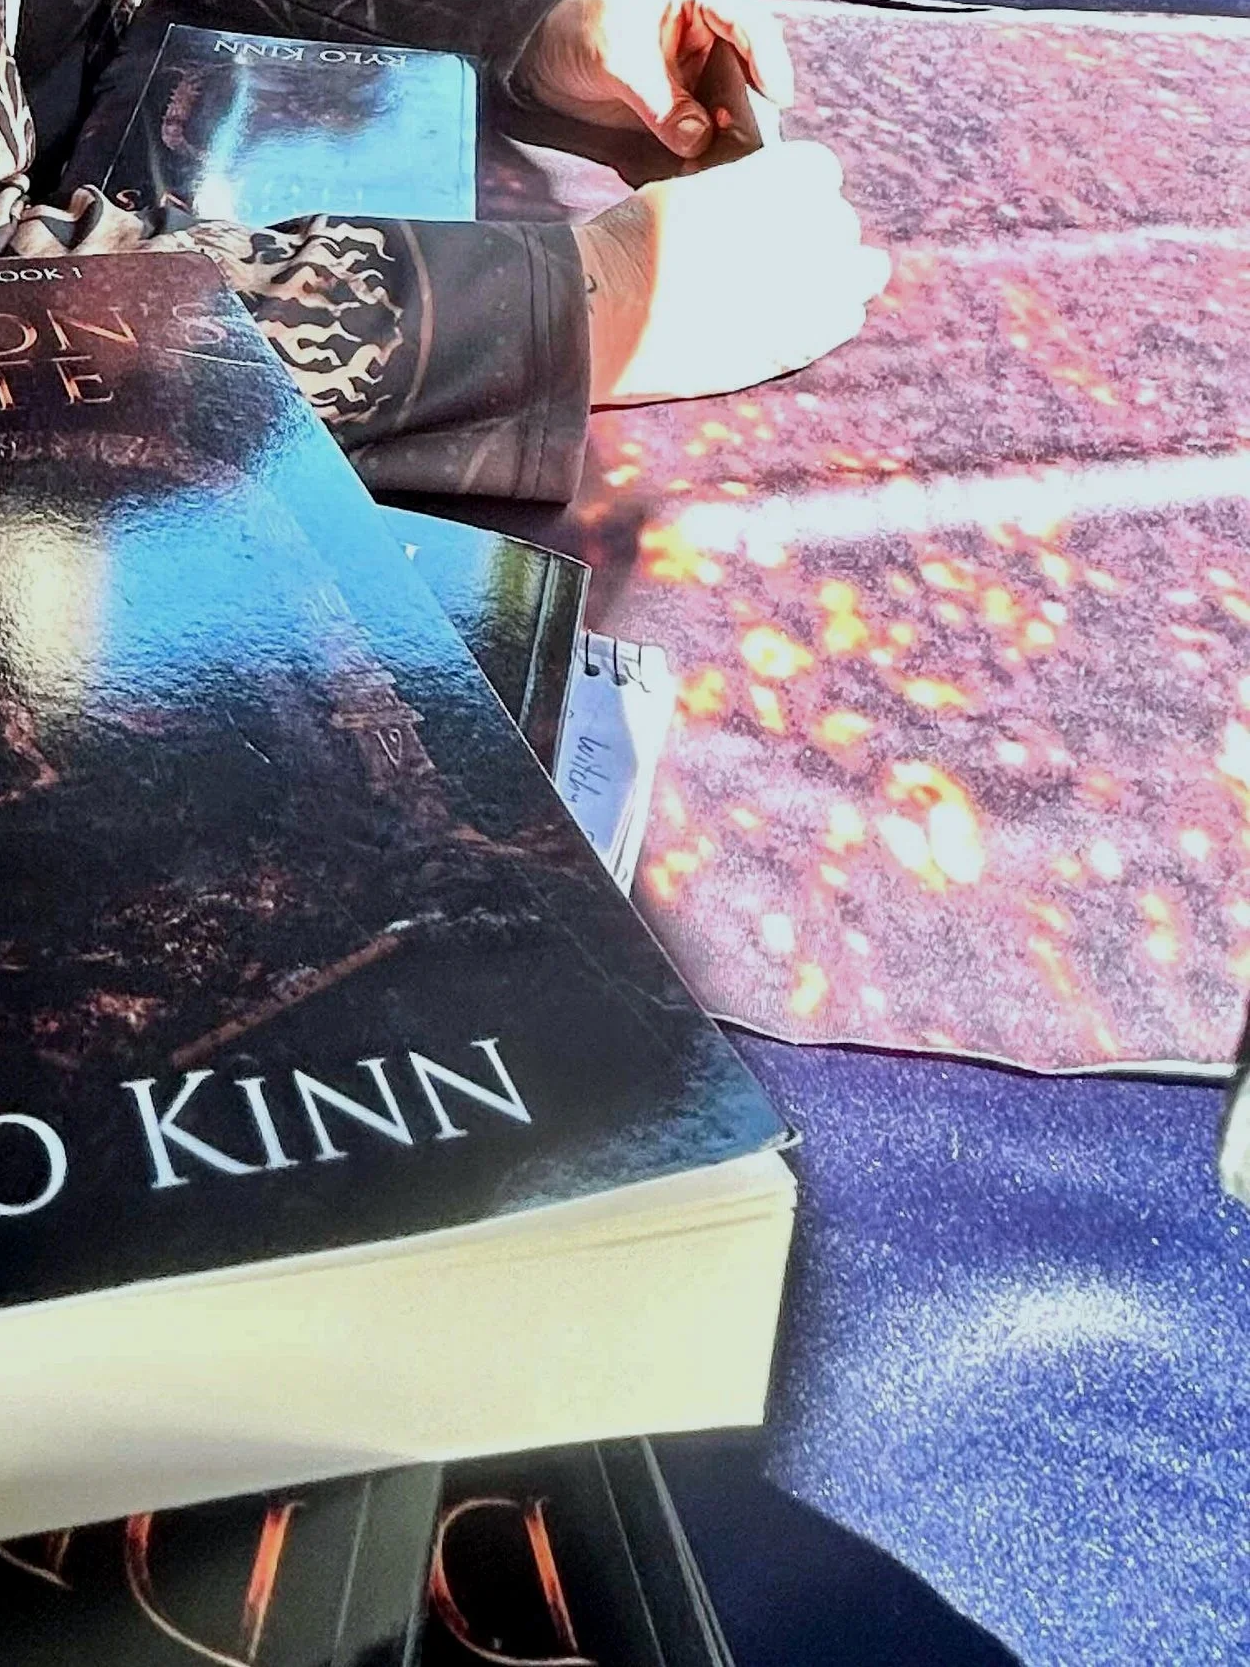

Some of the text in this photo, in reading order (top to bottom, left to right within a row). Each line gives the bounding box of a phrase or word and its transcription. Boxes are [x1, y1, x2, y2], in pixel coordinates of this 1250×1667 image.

[213, 39, 407, 68] RYLO KINN
[71, 266, 83, 280] 1
[120, 1036, 534, 1191] KINN
